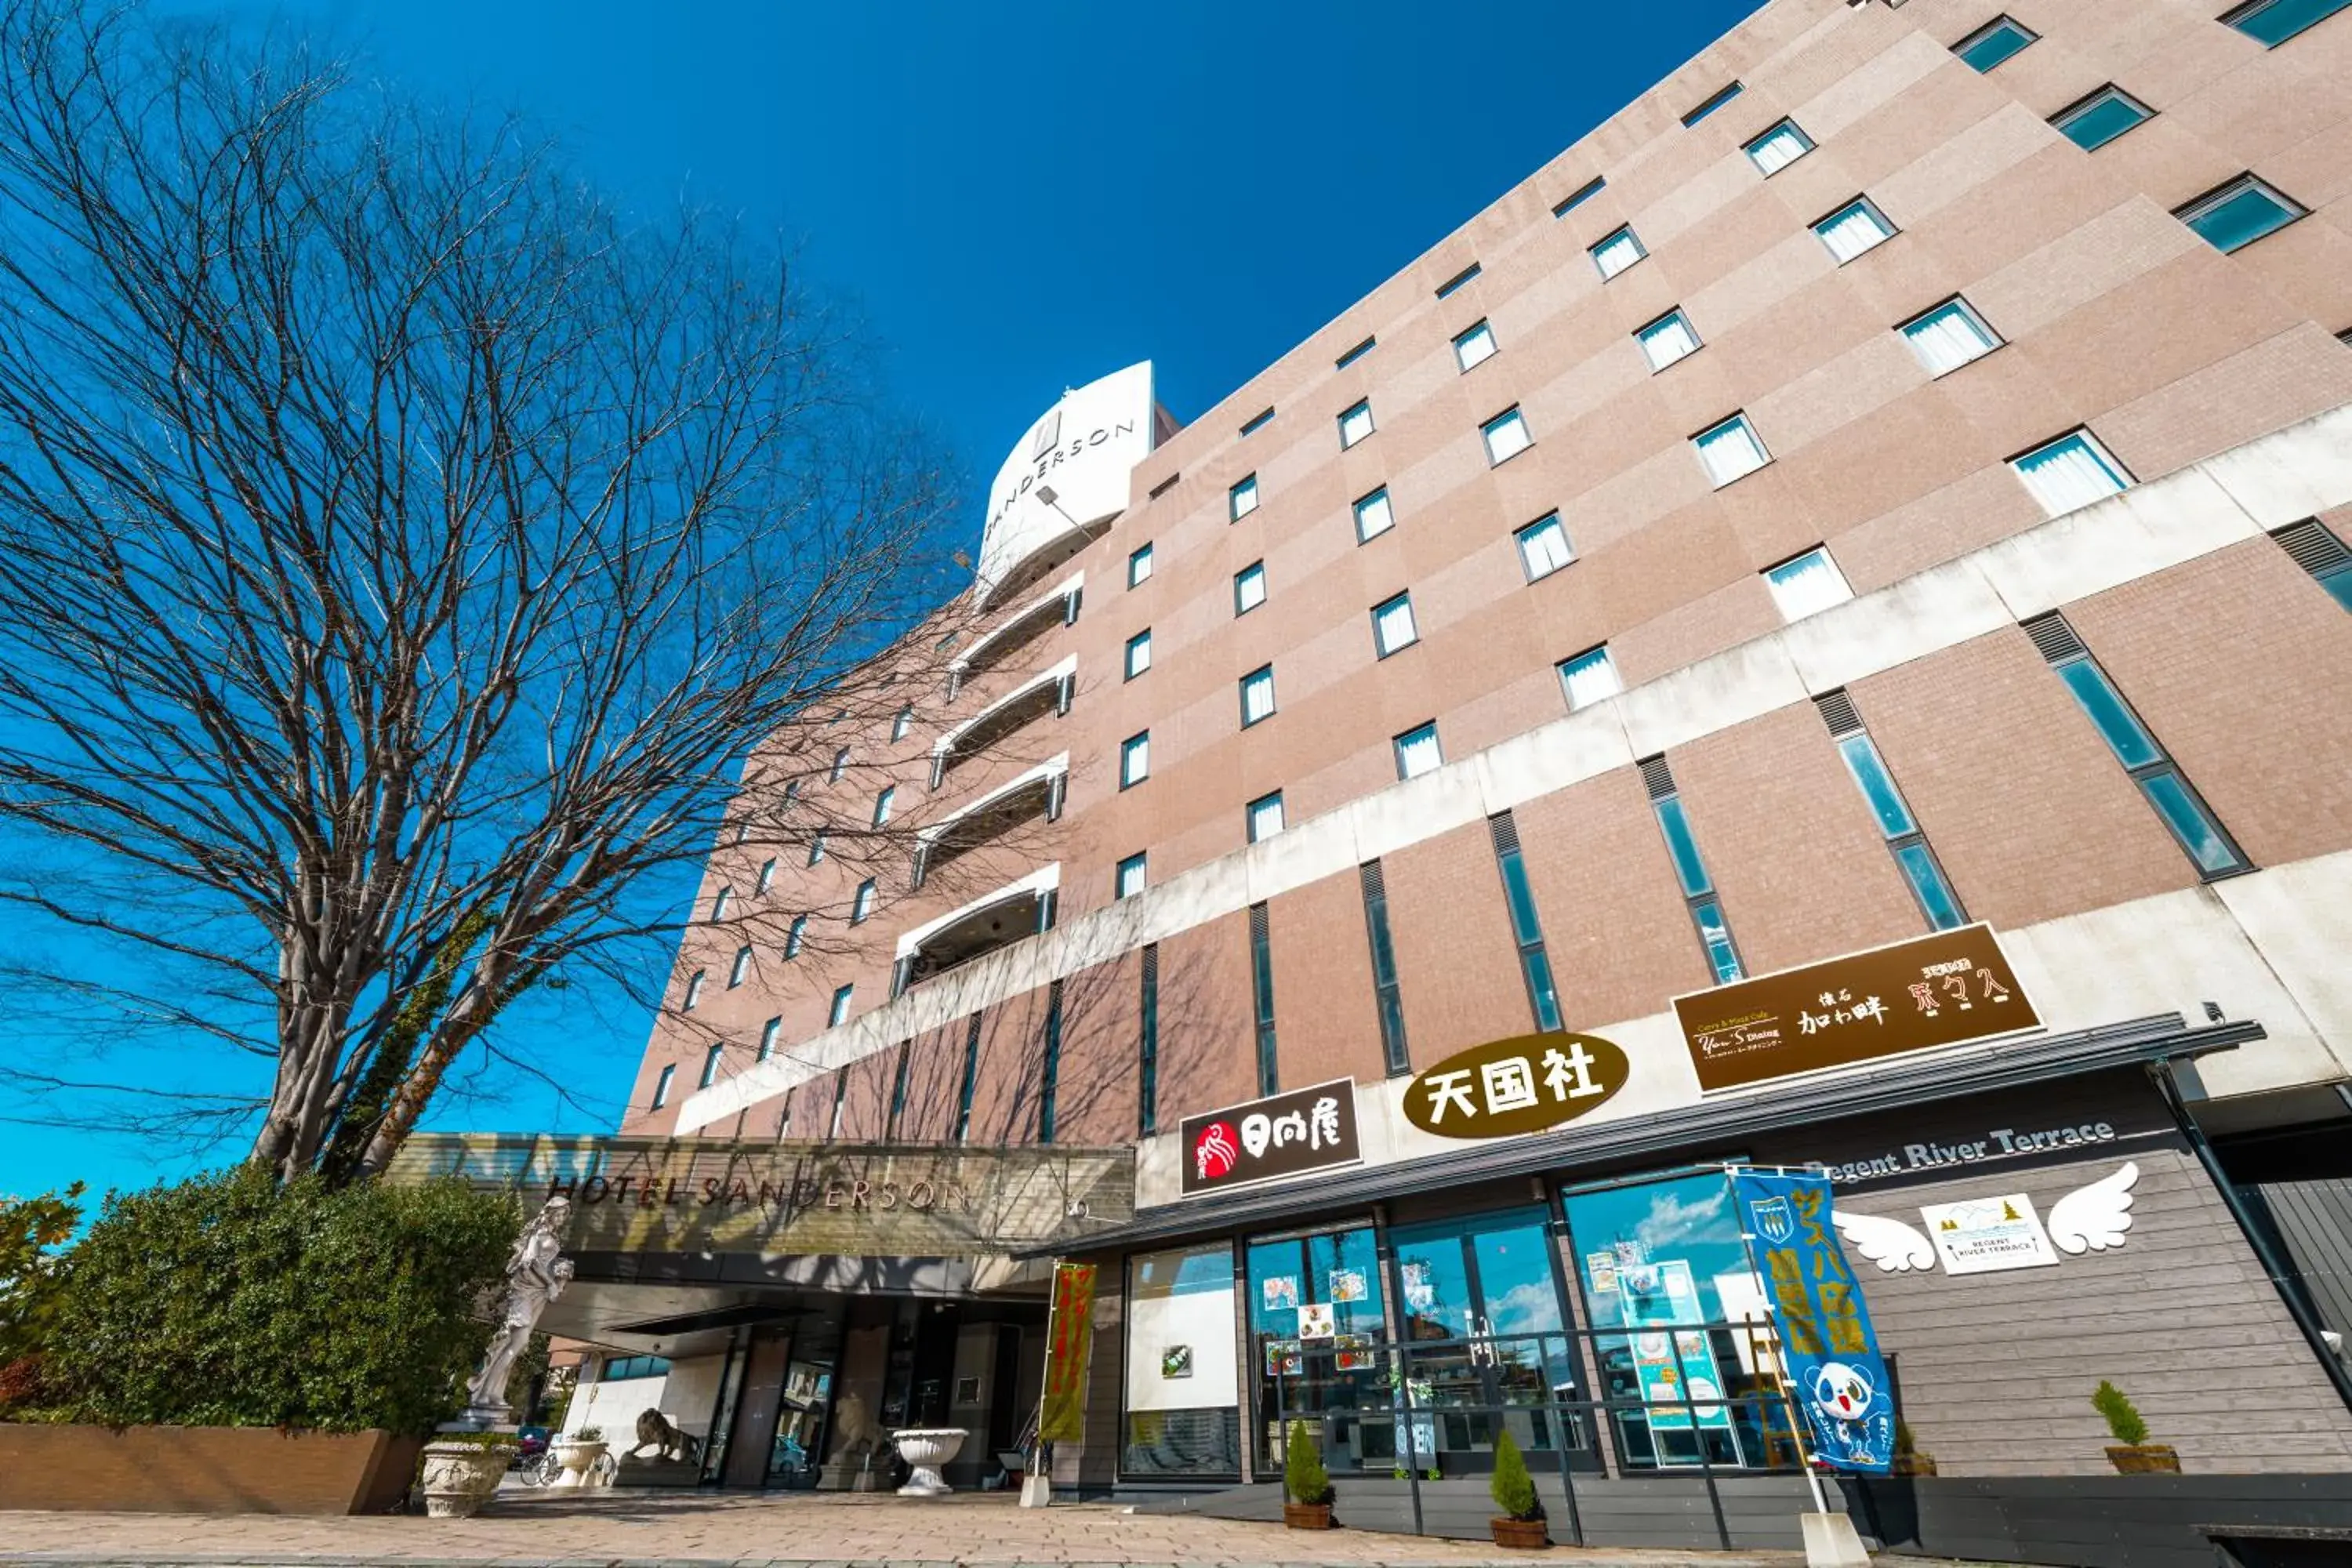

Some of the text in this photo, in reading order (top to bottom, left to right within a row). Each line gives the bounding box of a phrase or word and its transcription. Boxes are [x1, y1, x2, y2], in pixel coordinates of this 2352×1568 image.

[1425, 1042, 1605, 1125] 天国社
[1904, 1139, 1987, 1170] River
[1990, 1120, 2116, 1155] Terrace
[546, 1176, 971, 1214] HOTEL SANDERSON
[1958, 1247, 1986, 1256] RIVER
[1972, 1238, 2009, 1247] REGENT
[1396, 1423, 1436, 1454] OEN
